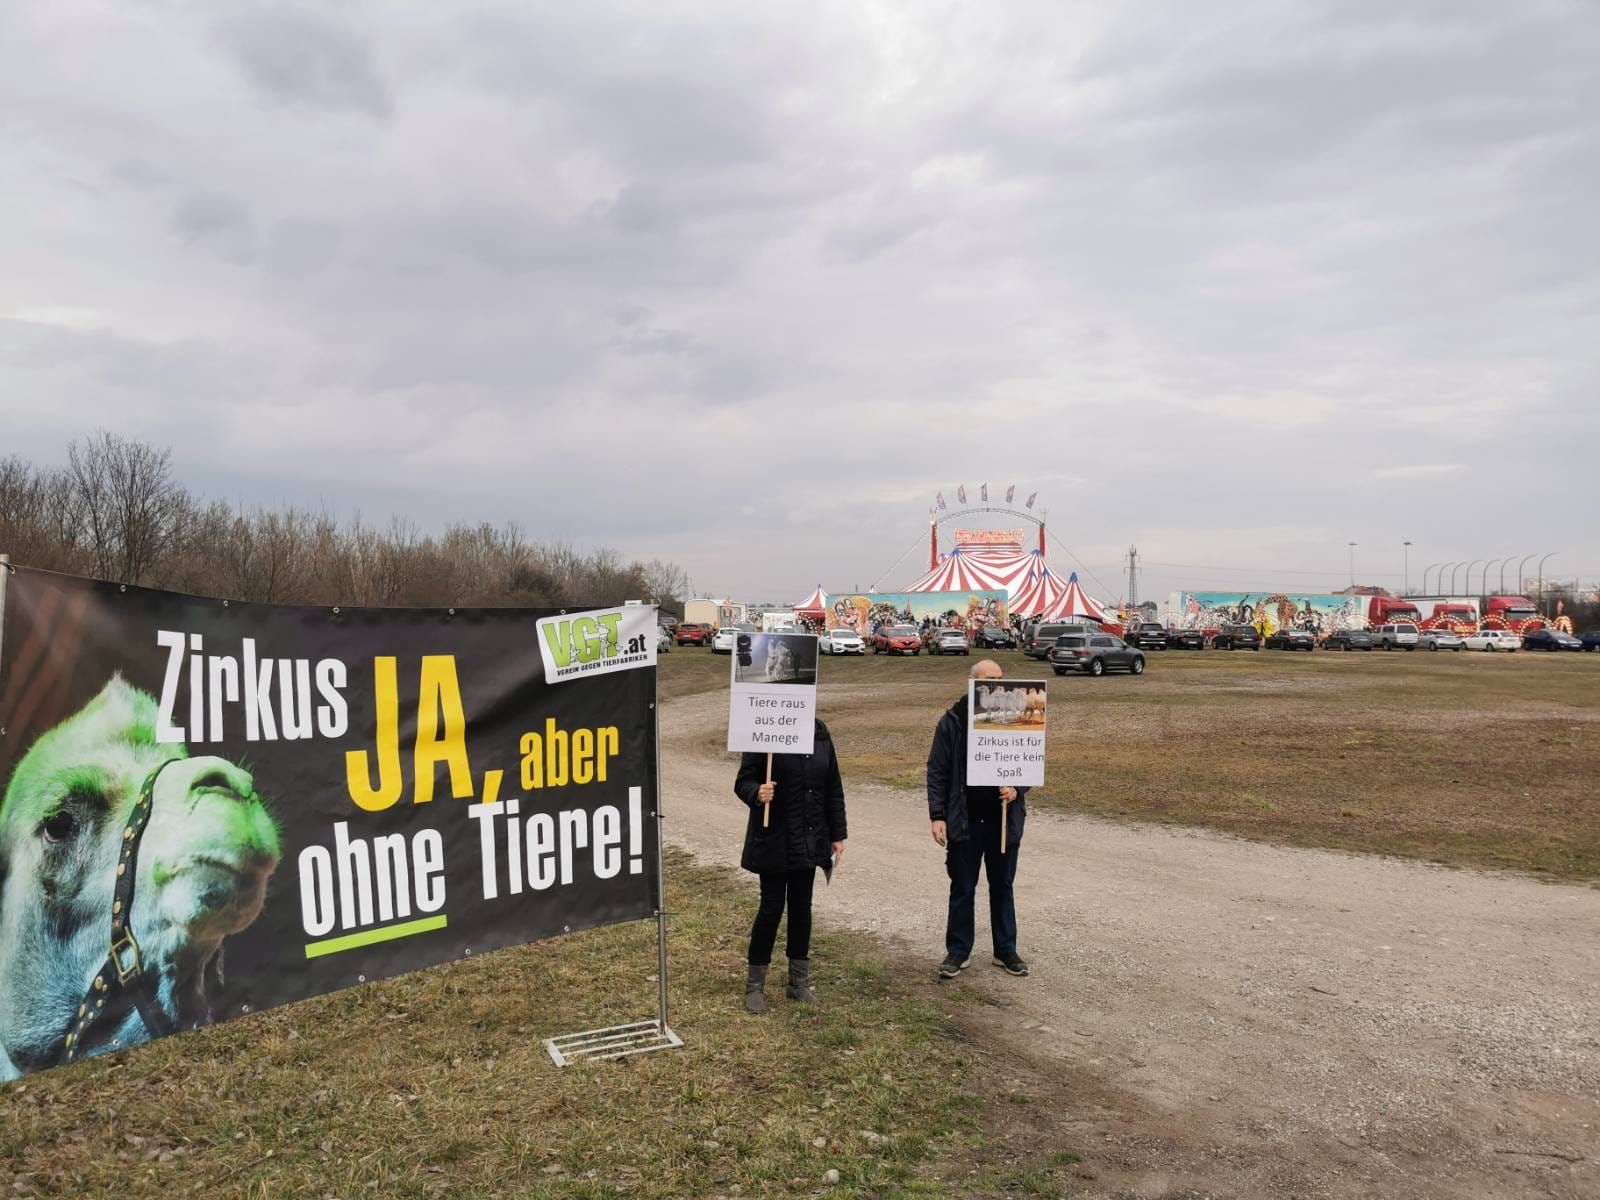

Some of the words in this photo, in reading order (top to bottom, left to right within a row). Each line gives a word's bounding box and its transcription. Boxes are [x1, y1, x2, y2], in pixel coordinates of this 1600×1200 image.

[557, 666, 579, 676] VEREIN
[581, 662, 601, 671] GEGEN
[602, 654, 648, 666] TIERFABRIKEN
[155, 630, 348, 743] Zirkus
[748, 696, 778, 708] Tiere
[781, 700, 806, 709] raus
[754, 716, 775, 726] aus
[778, 715, 797, 726] der
[345, 655, 504, 812] JA,
[519, 718, 619, 790] aber
[752, 732, 799, 746] Manege
[977, 737, 1009, 747] Zirkus
[1012, 737, 1024, 747] ist
[1027, 736, 1042, 747] für
[974, 752, 991, 762] die
[994, 752, 1020, 762] Tiere
[1023, 752, 1044, 762] kein
[996, 767, 1022, 779] Spaß
[298, 821, 446, 937] ohne
[468, 786, 643, 900] Tiere!
